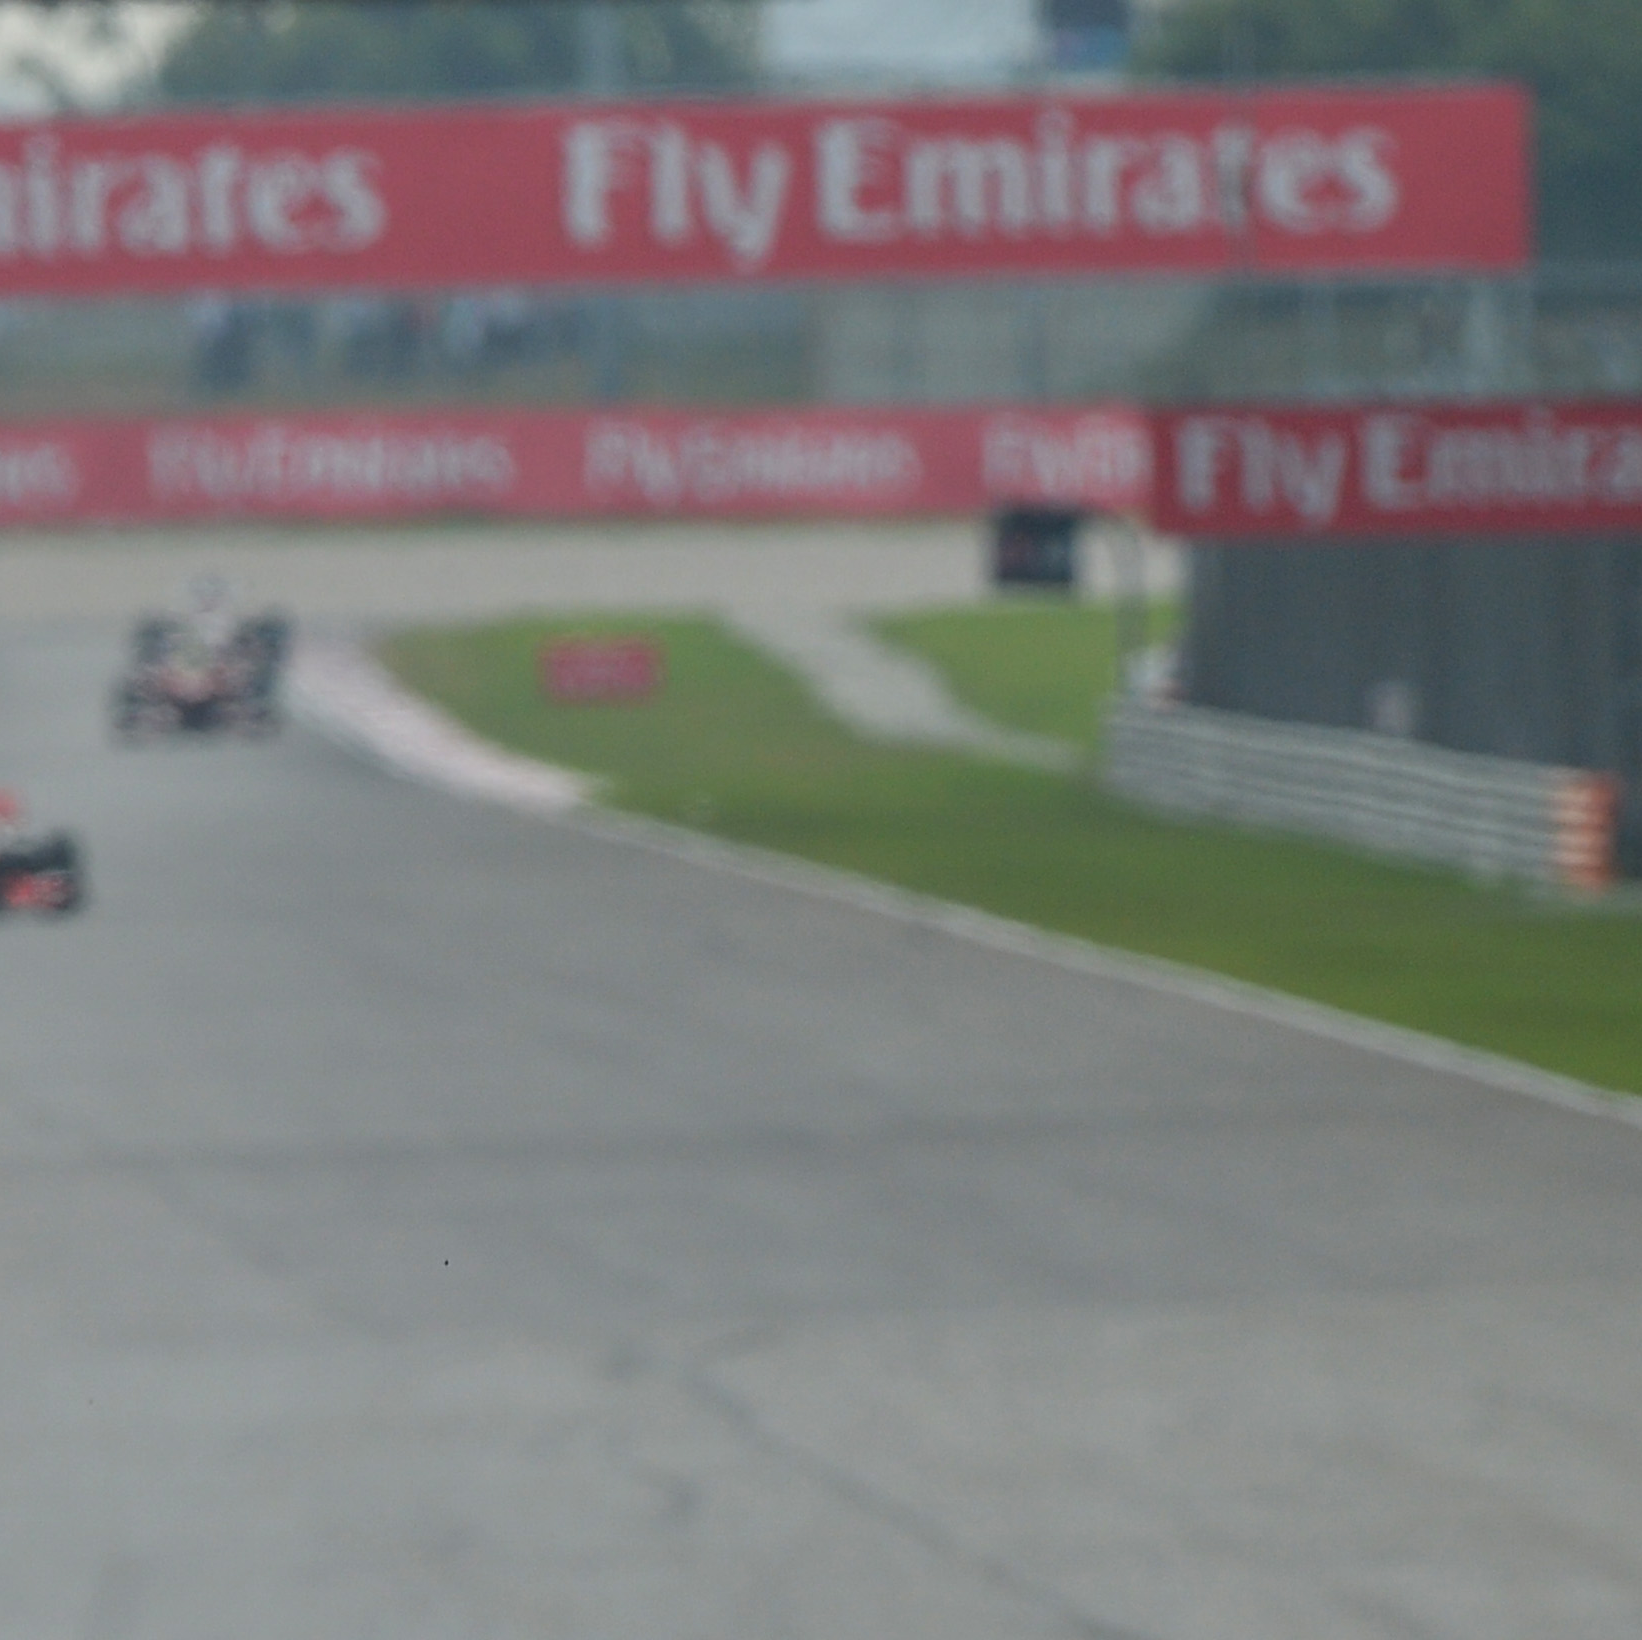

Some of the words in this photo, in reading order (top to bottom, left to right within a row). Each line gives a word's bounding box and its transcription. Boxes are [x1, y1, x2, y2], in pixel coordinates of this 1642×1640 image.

[565, 120, 789, 269] Fly
[815, 105, 1398, 243] Emirates
[1176, 415, 1347, 528] Fly
